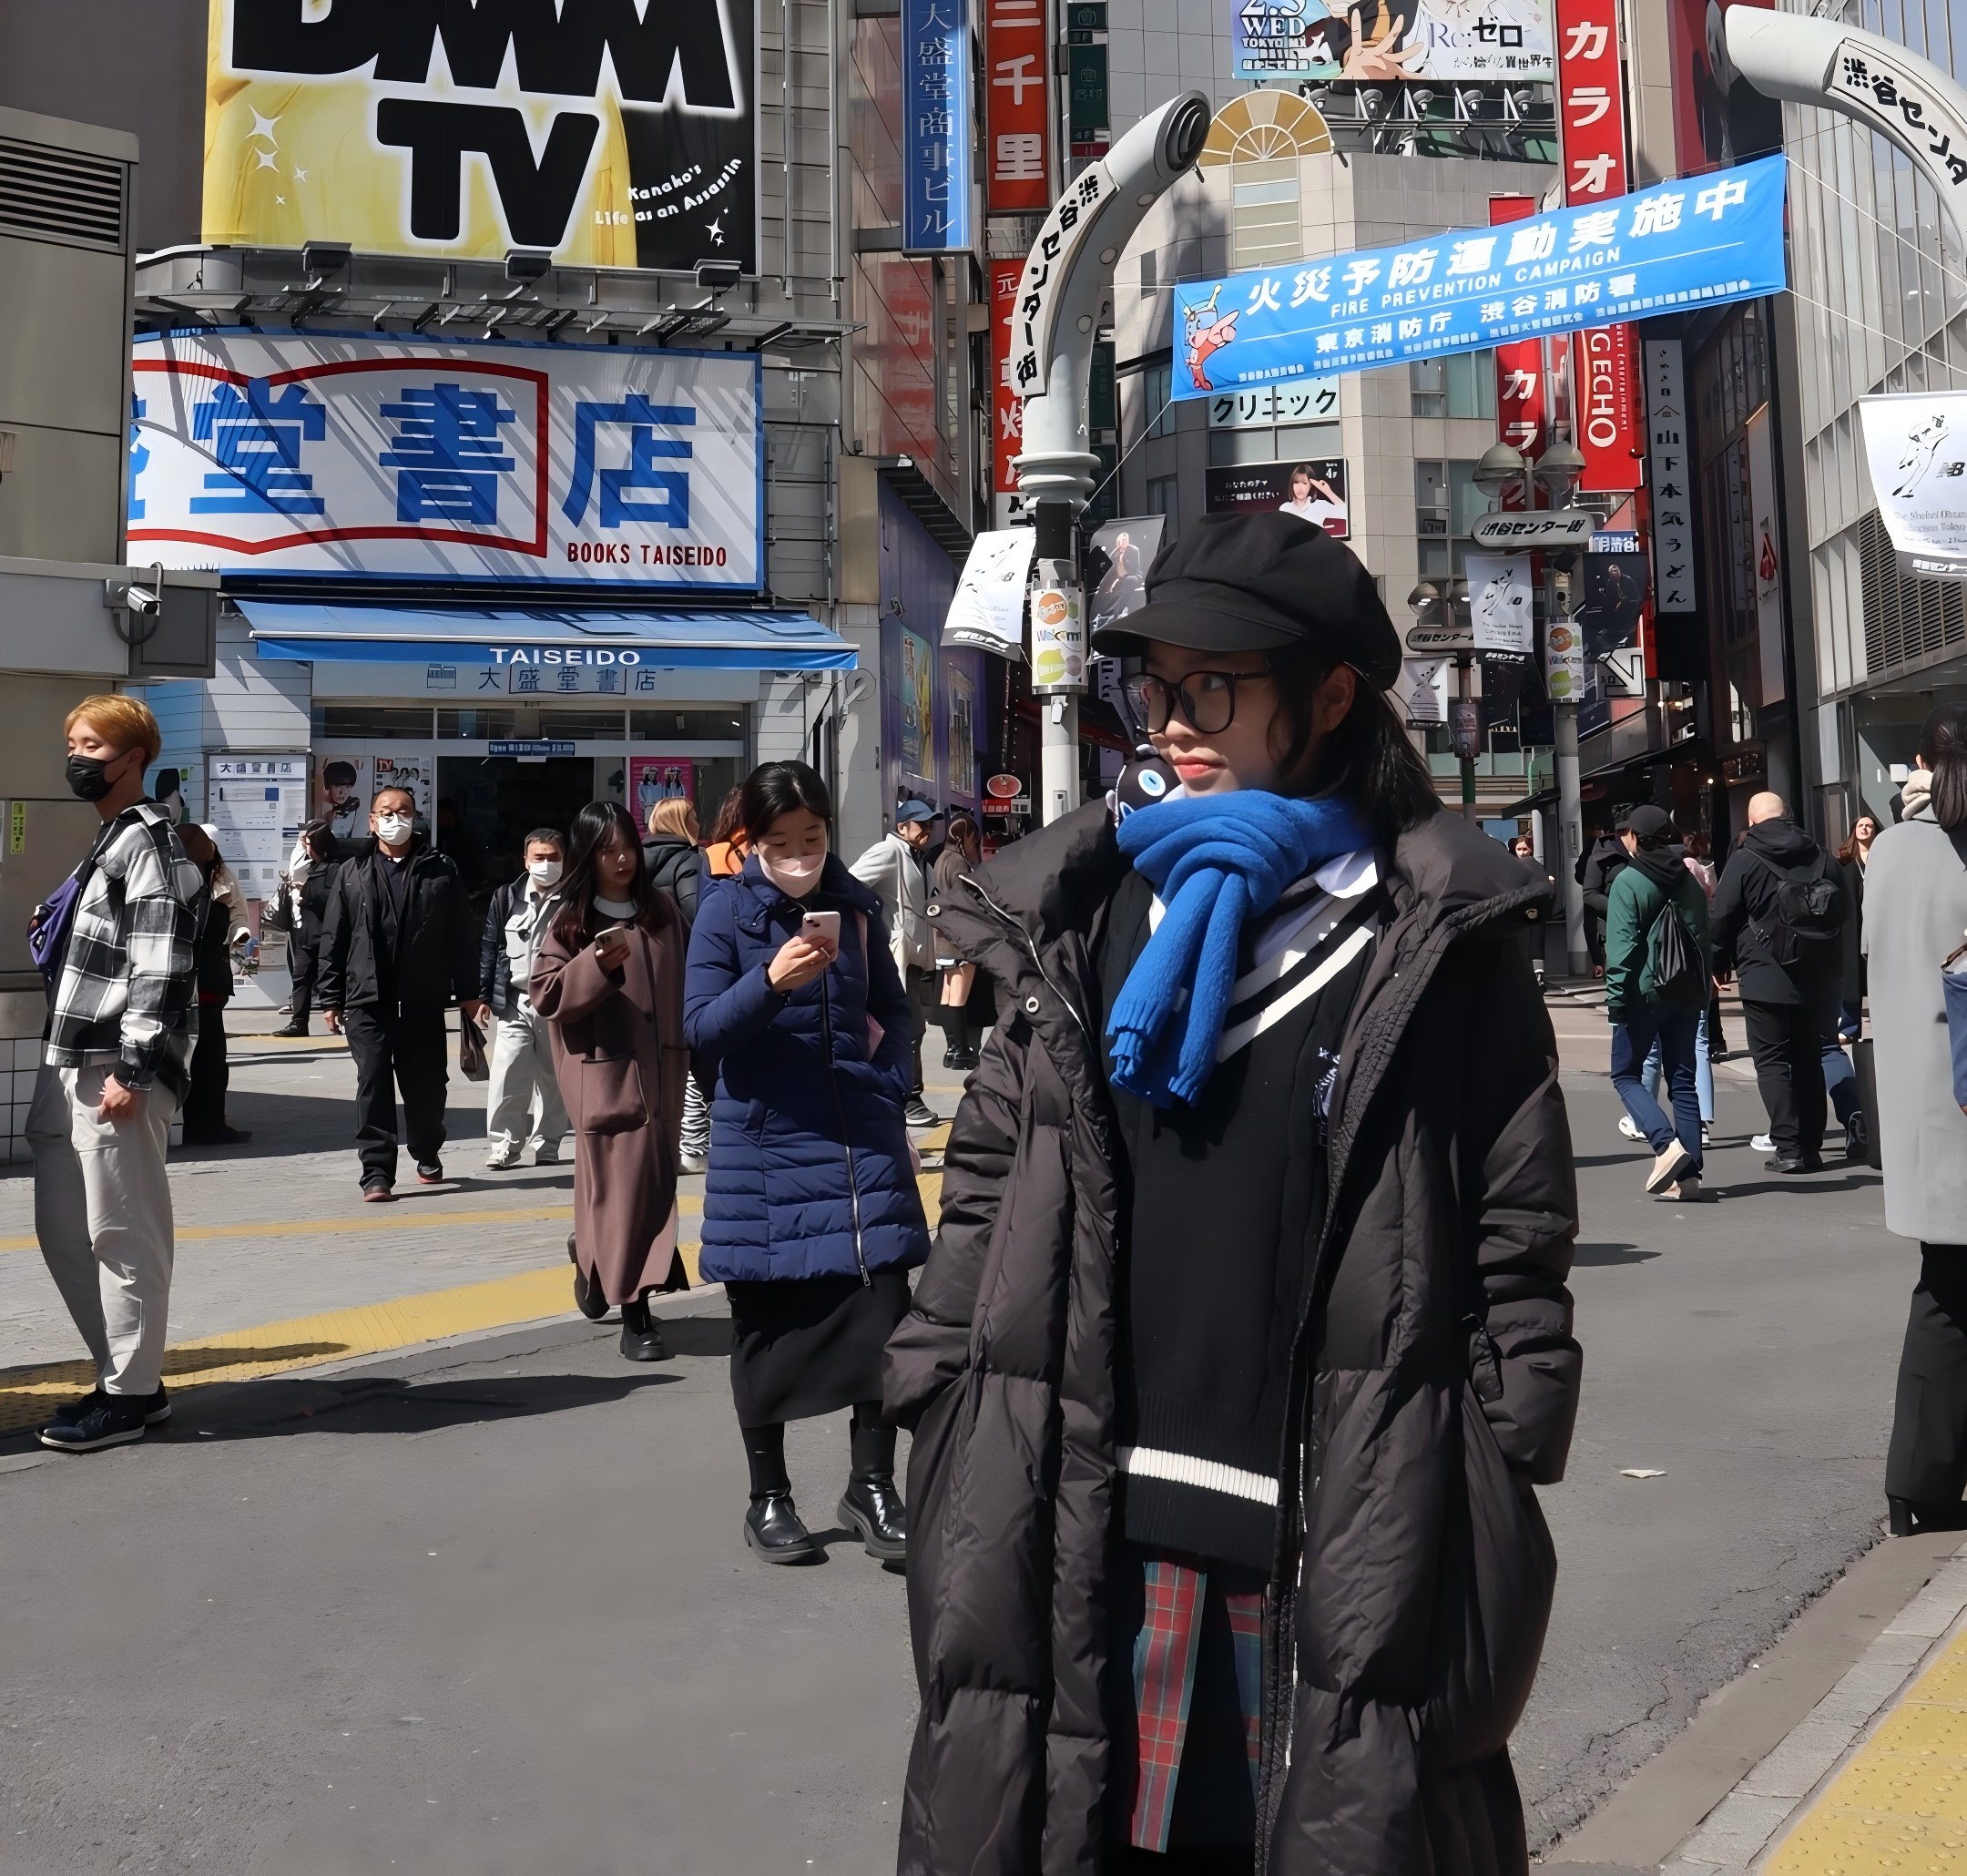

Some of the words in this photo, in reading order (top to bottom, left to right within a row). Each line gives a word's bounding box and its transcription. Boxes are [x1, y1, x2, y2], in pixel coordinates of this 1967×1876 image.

[1241, 16, 1306, 36] WED
[918, 3, 956, 236] 大盛堂商事ビル
[377, 97, 600, 247] TV
[628, 165, 702, 201] Kanako's
[636, 210, 653, 221] as
[657, 204, 678, 219] an
[684, 158, 742, 210] Assassin
[1016, 174, 1100, 389] 渋谷センター街
[1245, 179, 1748, 317] 火災予防運動実施中
[1330, 298, 1369, 318] FIRE
[1381, 272, 1501, 309] PREVENTION
[1514, 246, 1621, 283] CAMPAIGN
[1315, 311, 1452, 354] 東京消防庁
[1480, 273, 1636, 323] 渋谷消防署
[1213, 388, 1337, 423] クリニック
[1587, 360, 1617, 448] ECHO
[127, 377, 697, 530] 堂書店
[567, 542, 630, 564] BOOKS
[640, 544, 727, 567] TAISEIDO
[1656, 429, 1687, 604] 山下本気うどん
[489, 647, 640, 666] TAISEIDO
